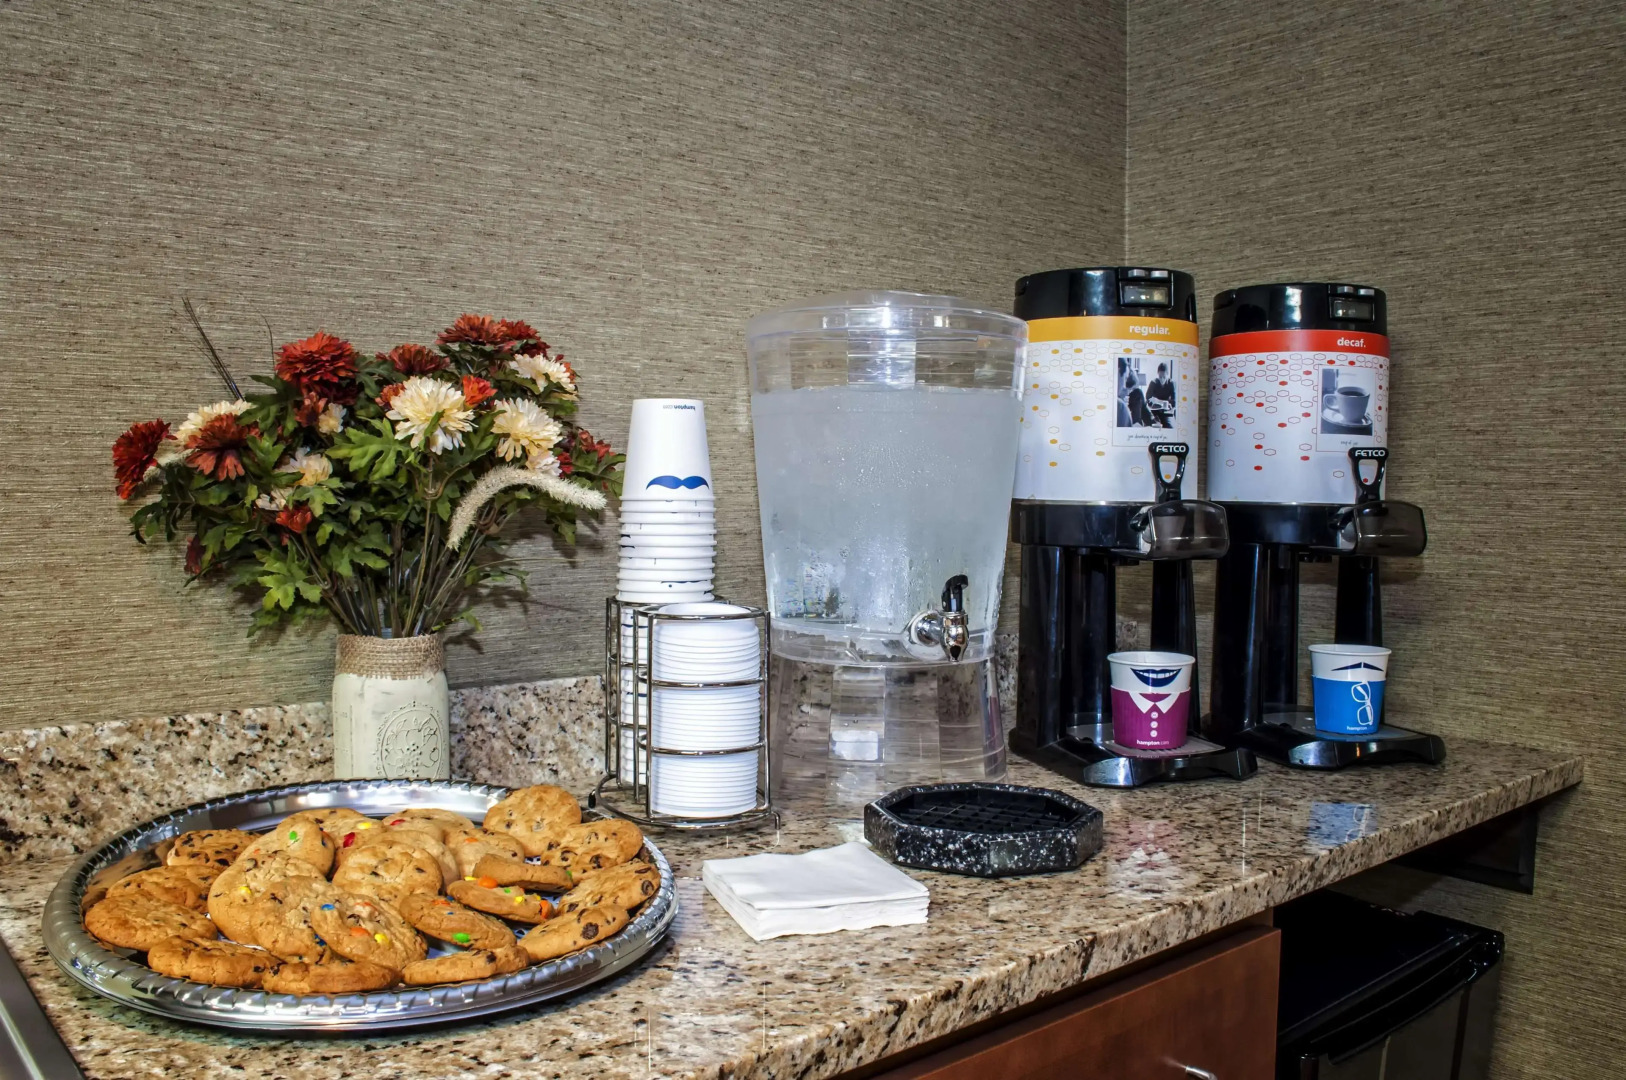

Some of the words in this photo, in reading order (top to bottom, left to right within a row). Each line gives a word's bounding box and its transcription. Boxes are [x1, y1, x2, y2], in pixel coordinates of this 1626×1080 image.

[1129, 324, 1171, 336] regular.
[1336, 337, 1367, 348] decaf.
[1156, 445, 1186, 453] FETCO
[1355, 449, 1386, 457] FETCO
